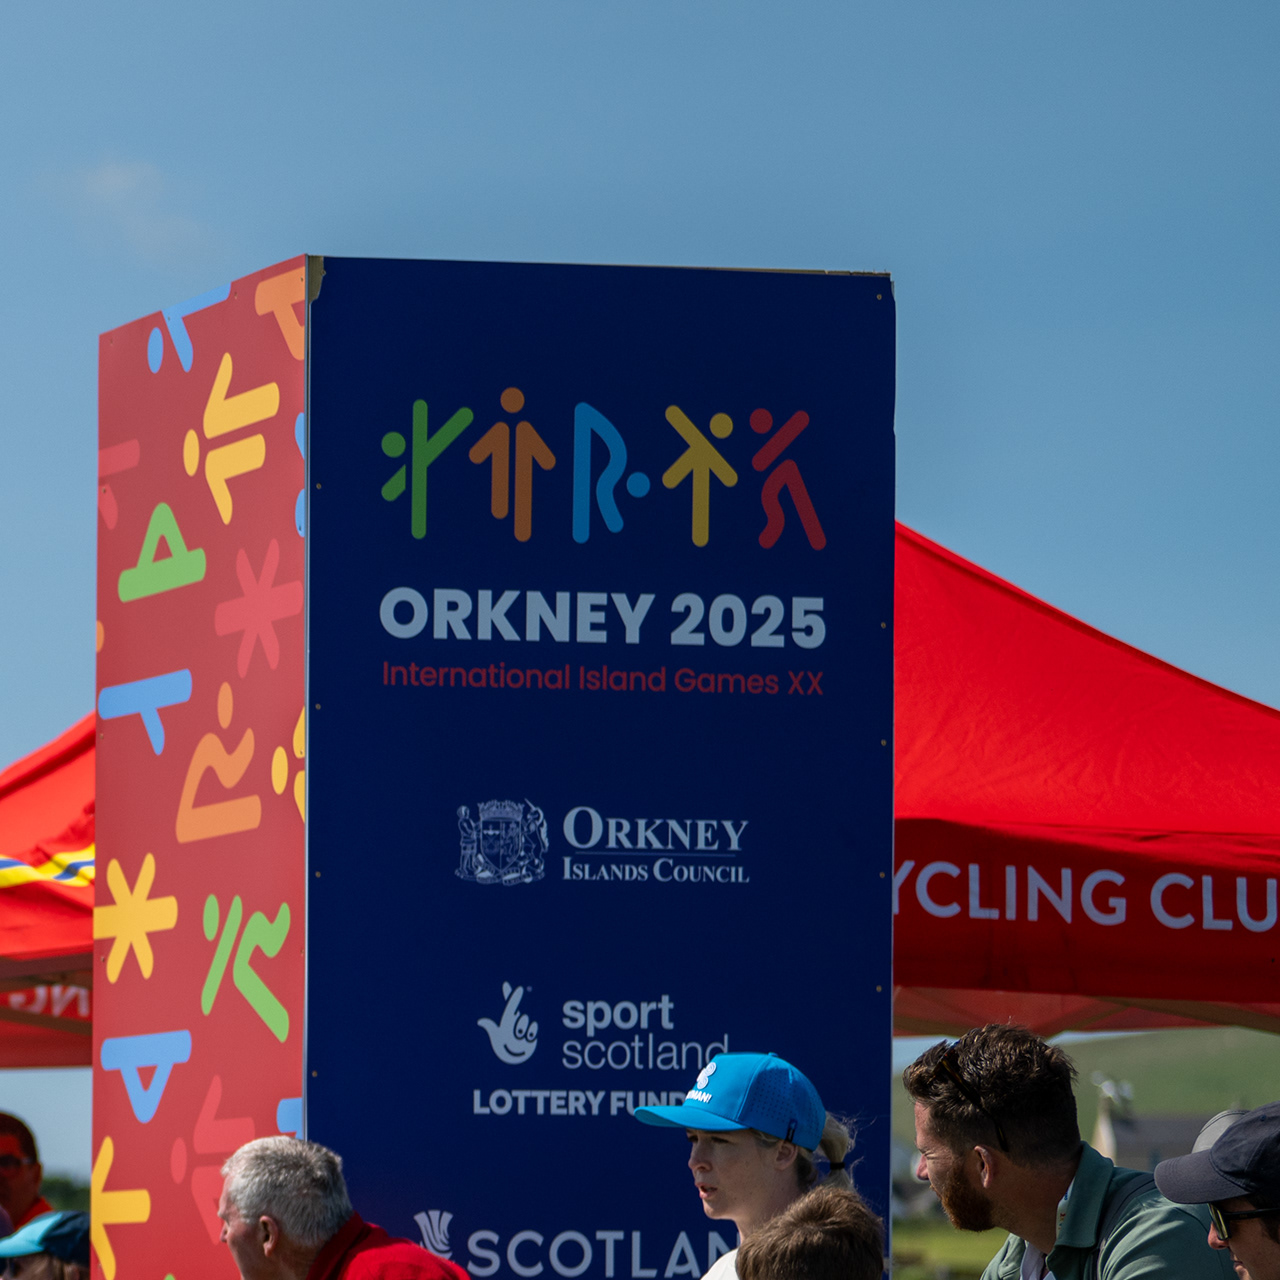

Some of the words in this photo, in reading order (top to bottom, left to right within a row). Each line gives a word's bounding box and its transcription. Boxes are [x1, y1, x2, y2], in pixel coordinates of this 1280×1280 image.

[379, 586, 656, 645] ORKNEY
[670, 592, 827, 650] 2025
[382, 661, 570, 690] International
[578, 664, 666, 693] Island
[674, 668, 780, 695] Games
[787, 671, 824, 696] XX
[562, 806, 749, 852] ORKNEY
[562, 857, 649, 883] ISLANDS
[653, 857, 751, 884] COUNCIL
[562, 994, 674, 1037] sport
[473, 1089, 606, 1116] LOTTERY
